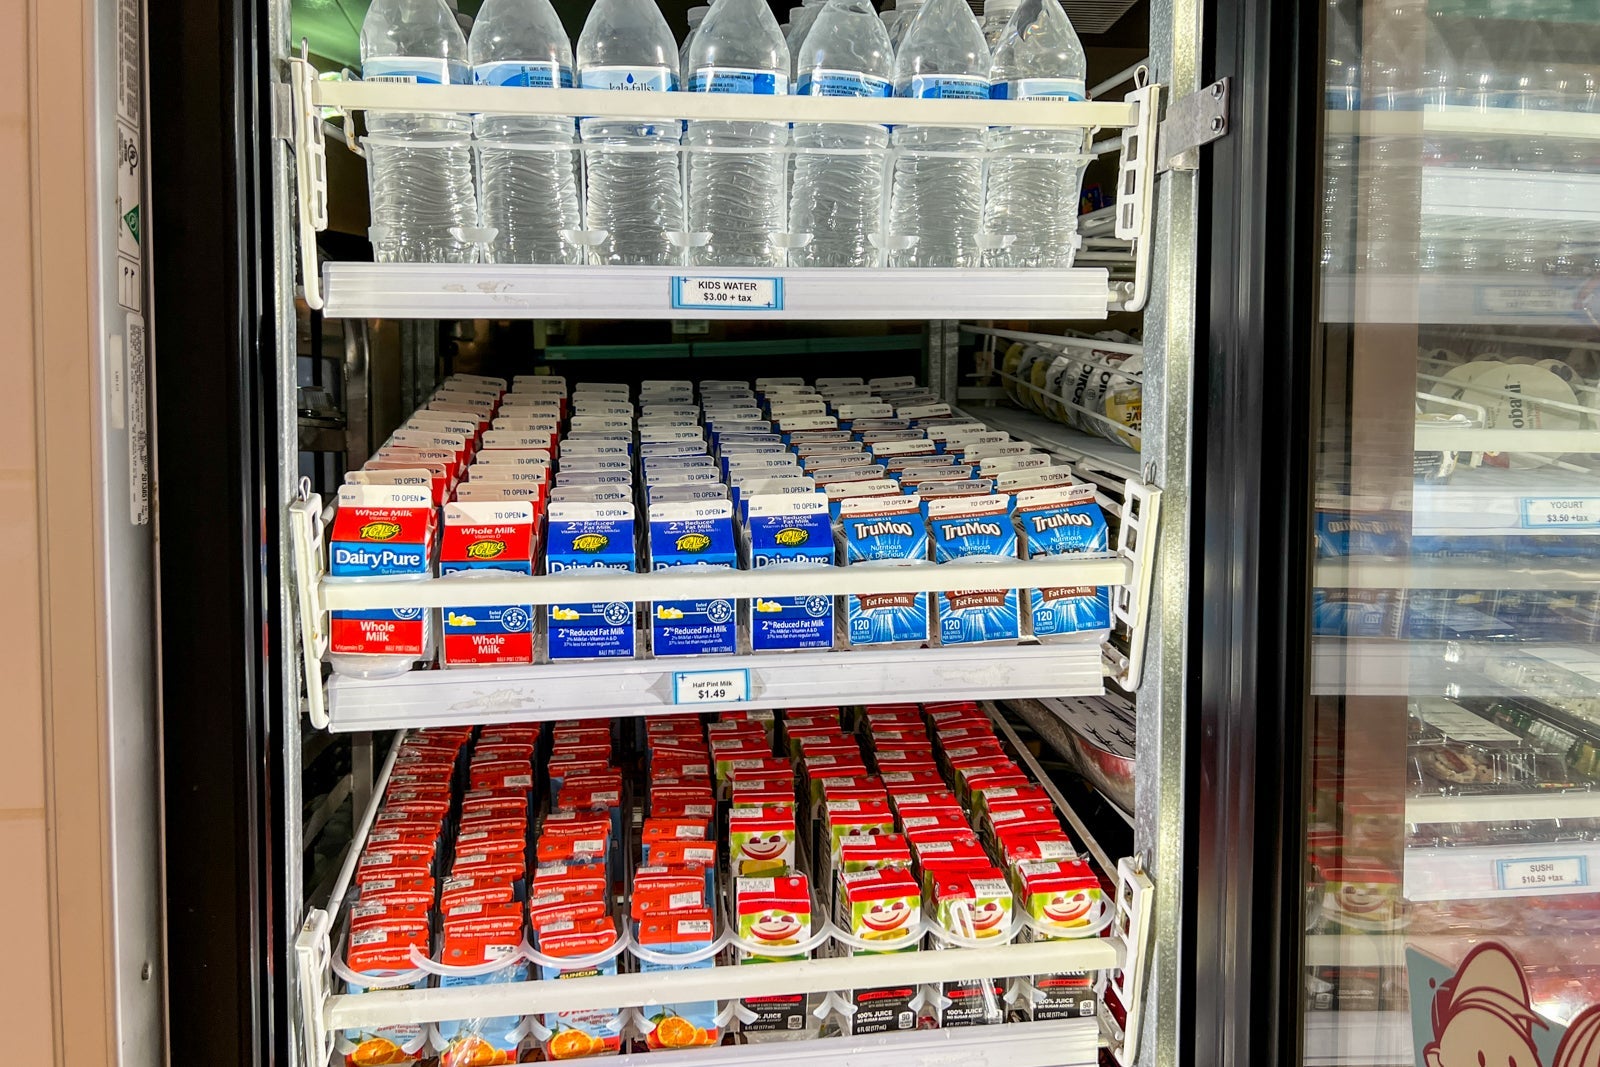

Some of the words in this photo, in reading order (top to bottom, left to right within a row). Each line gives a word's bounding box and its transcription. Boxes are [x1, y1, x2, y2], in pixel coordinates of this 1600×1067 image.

[698, 281, 720, 290] KIDS
[723, 282, 756, 290] WATER
[704, 292, 727, 301] $3.00
[768, 516, 782, 525] 2%
[1032, 513, 1092, 532] TruMoo
[1547, 514, 1568, 522] $3.50
[567, 522, 583, 530] 2%
[669, 522, 684, 530] 2%
[854, 522, 912, 540] TruMoo
[942, 522, 1001, 540] TruMoo
[336, 550, 420, 568] DairyPure
[1036, 611, 1052, 621] 120
[360, 622, 394, 632] Whole
[762, 621, 772, 630] 2%
[854, 620, 869, 630] 120
[944, 620, 960, 630] 120
[558, 628, 570, 638] 2%
[664, 627, 674, 636] 2%
[366, 632, 389, 642] Milk
[472, 636, 505, 644] Whole
[478, 644, 500, 654] Milk
[698, 690, 726, 699] $1.49
[1530, 864, 1554, 872] SUSHI
[1522, 875, 1546, 884] $10.50
